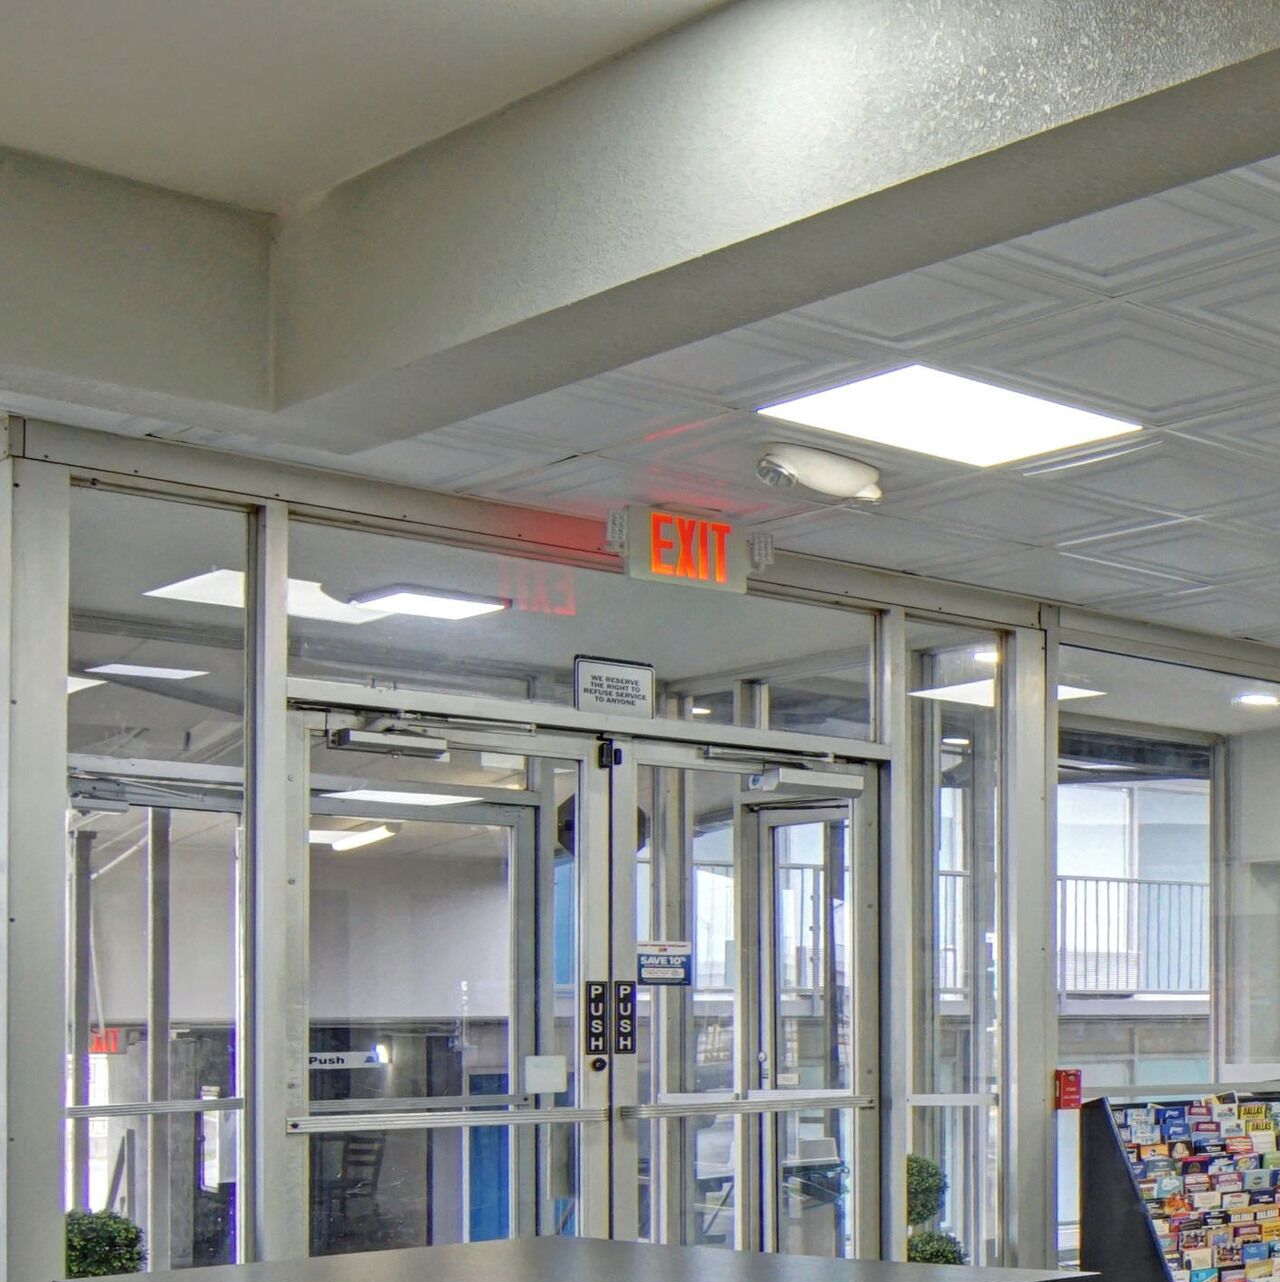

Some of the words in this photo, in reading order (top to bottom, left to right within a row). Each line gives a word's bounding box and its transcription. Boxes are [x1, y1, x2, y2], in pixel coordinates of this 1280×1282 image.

[651, 511, 733, 584] EXIT
[591, 674, 605, 682] WE
[605, 676, 640, 686] RESERVE
[590, 681, 605, 689] THE
[606, 683, 629, 691] RIGHT
[583, 687, 614, 697] REFUSE
[615, 691, 647, 701] SERVICE
[595, 695, 605, 703] TO
[606, 697, 636, 706] ANYONE
[640, 955, 669, 965] SAVE
[590, 985, 604, 1051] PUSH
[619, 985, 632, 1050] PUSH
[308, 1056, 345, 1065] Push
[1242, 1105, 1264, 1116] DALLAS
[1251, 1120, 1272, 1131] DALLAS
